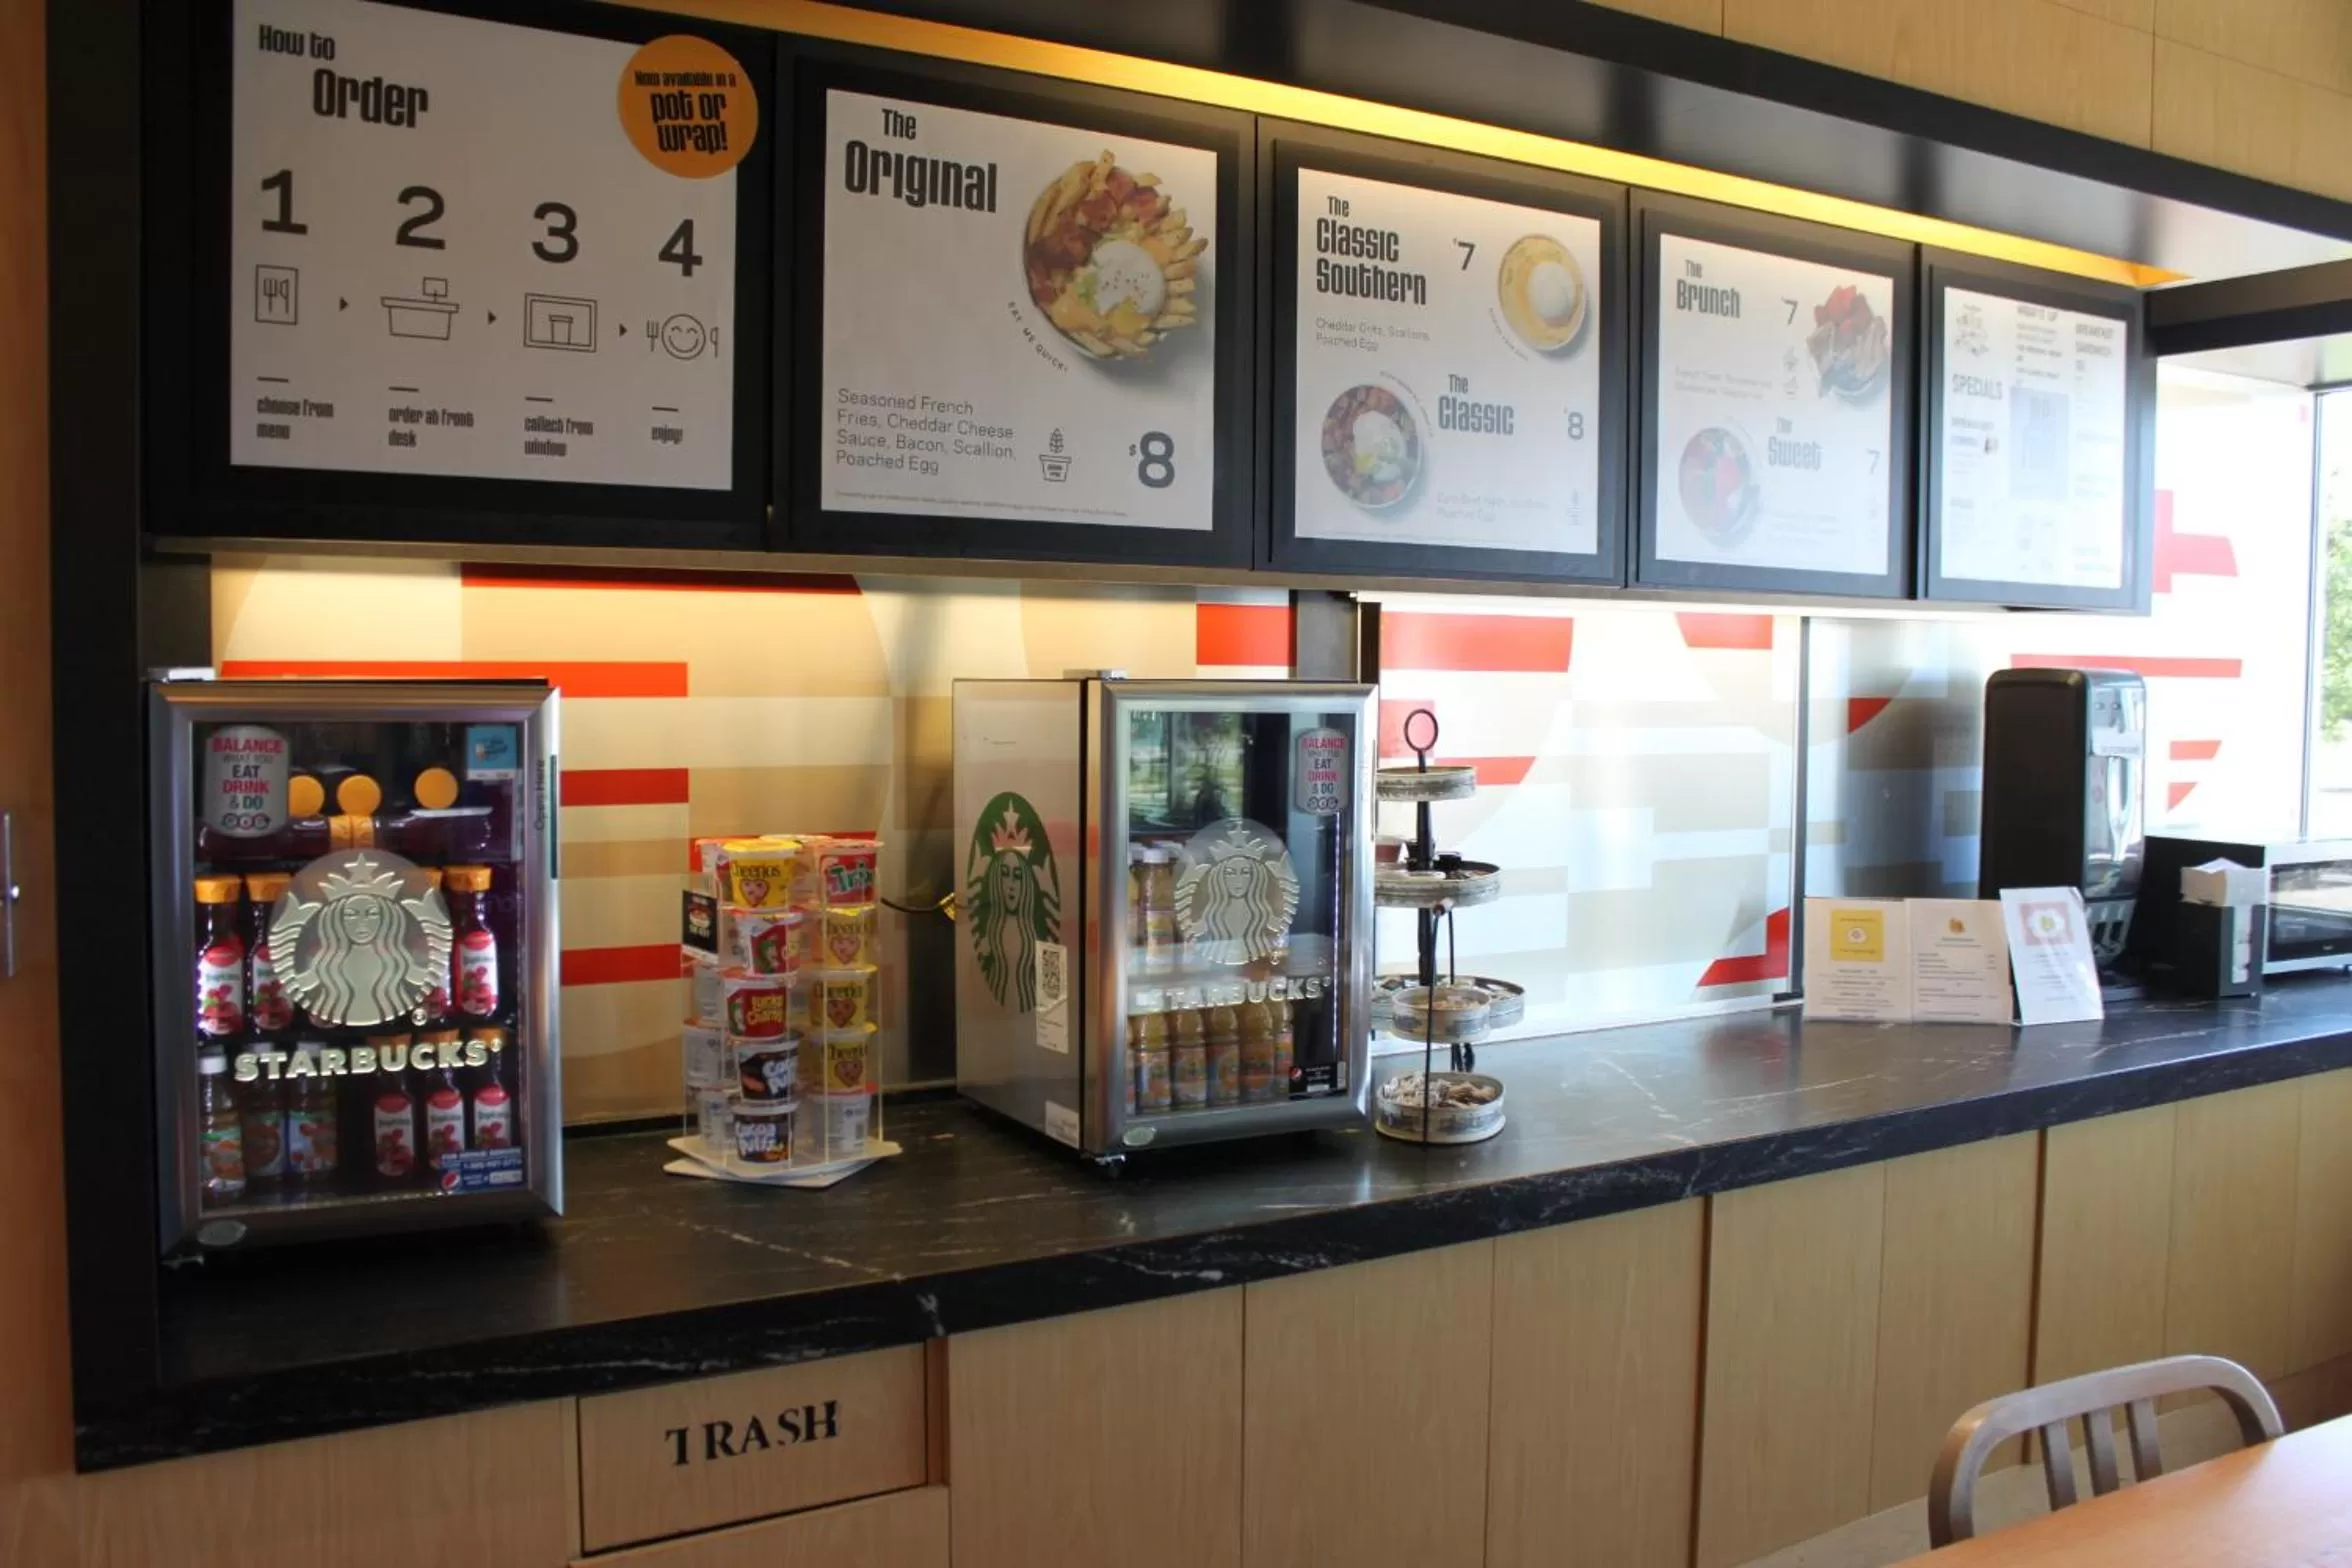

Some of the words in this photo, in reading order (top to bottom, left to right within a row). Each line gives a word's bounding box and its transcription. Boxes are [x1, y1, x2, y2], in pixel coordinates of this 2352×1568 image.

[259, 24, 304, 57] How
[309, 33, 336, 61] to
[313, 68, 429, 128] Order
[650, 90, 694, 124] pot
[698, 93, 727, 121] or
[656, 121, 728, 154] wrap!
[882, 108, 917, 140] The
[845, 140, 997, 213] Original
[261, 169, 308, 235] 1
[395, 186, 446, 250] 2
[1328, 196, 1350, 218] The
[531, 202, 579, 264] 3
[658, 218, 703, 277] 4
[1316, 217, 1399, 264] Classic
[1316, 258, 1427, 305] Southern
[1676, 278, 1741, 319] Brunch
[1448, 373, 1469, 395] The
[838, 388, 916, 410] Seasoned
[921, 396, 974, 415] French
[1438, 395, 1515, 436] Classic
[837, 409, 882, 429] Fries,
[887, 414, 953, 433] Cheddar
[957, 420, 1014, 439] Cheese
[836, 429, 890, 450] Sauce,
[896, 434, 948, 455] Bacon,
[953, 440, 1017, 461] Scallion,
[1767, 436, 1823, 472] Sweet
[836, 450, 904, 469] Poached
[908, 455, 940, 475] Egg
[212, 736, 283, 754] BALANCE
[1303, 737, 1345, 750] BALANCE
[232, 765, 261, 779] EAT
[1308, 771, 1338, 783] DRINK
[1314, 758, 1333, 770] EAT
[222, 779, 271, 795] DRINK
[242, 795, 265, 811] DO
[234, 1039, 488, 1081] STARBUCKS
[664, 1400, 838, 1467] TRASH
